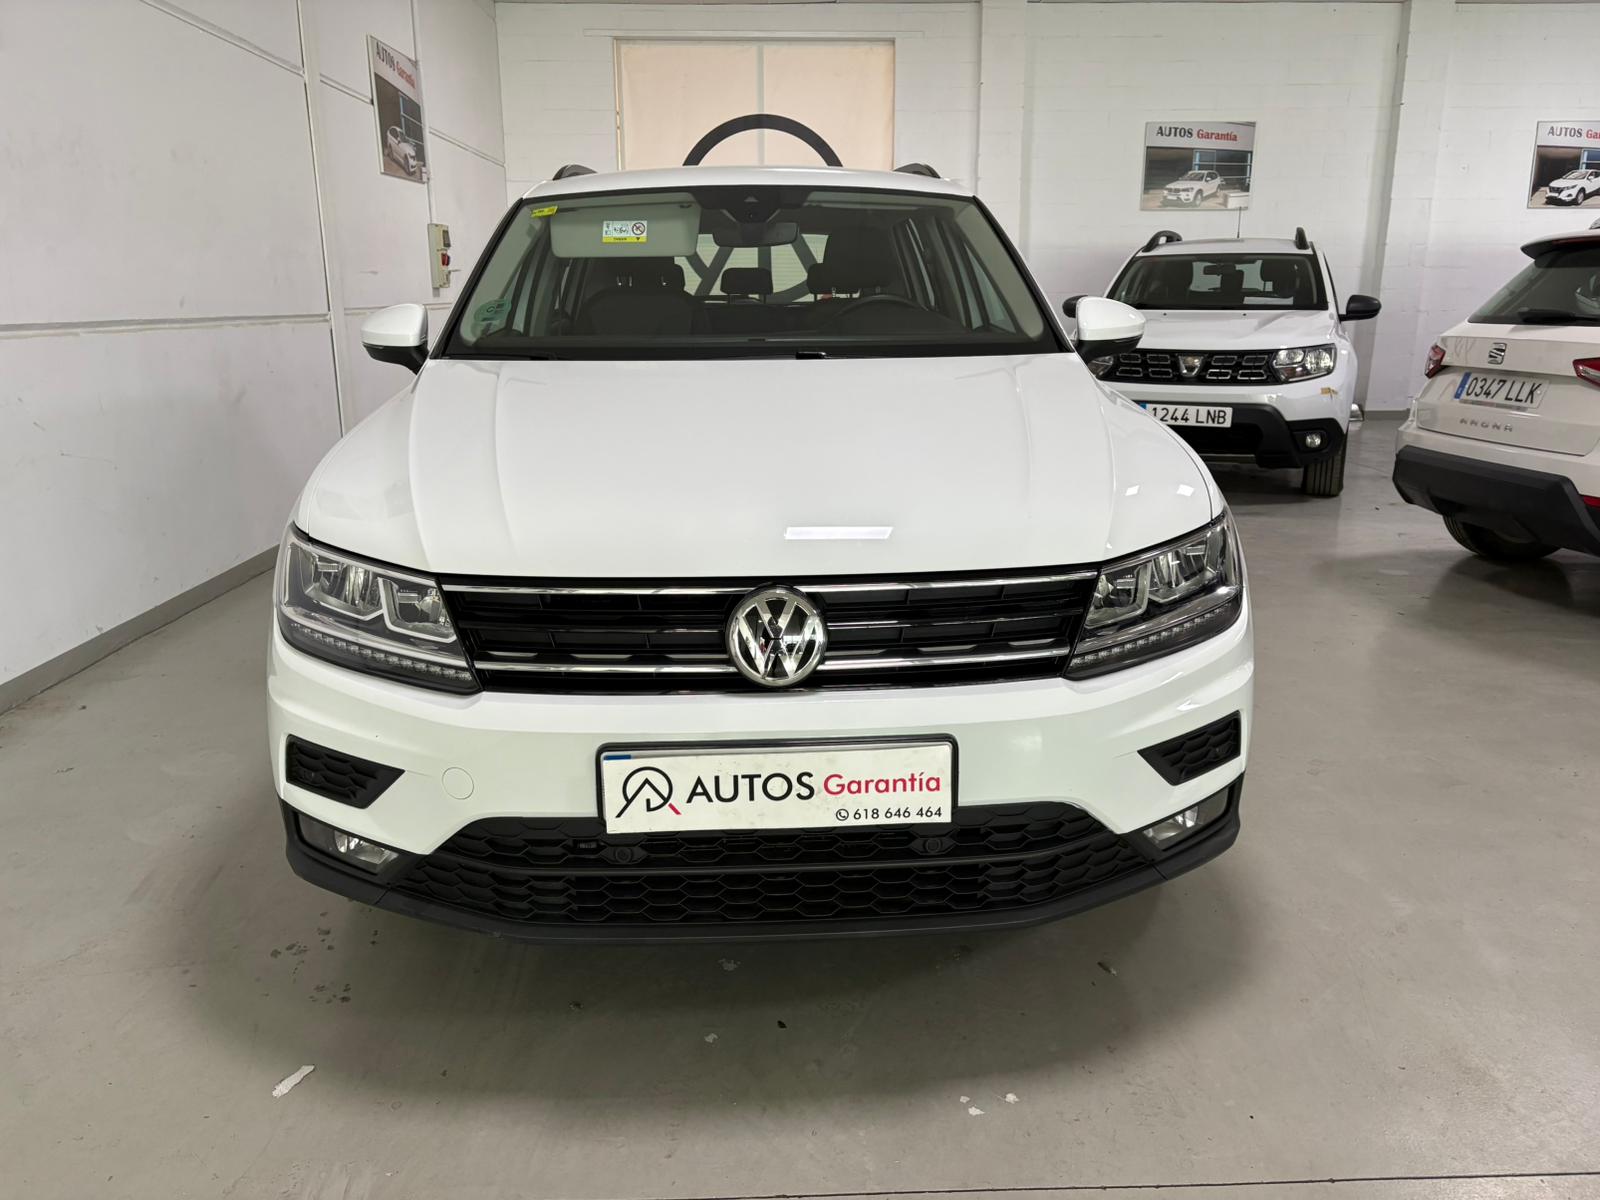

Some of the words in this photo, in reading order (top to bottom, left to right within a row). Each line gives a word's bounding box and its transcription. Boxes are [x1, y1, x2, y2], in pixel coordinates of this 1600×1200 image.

[1156, 126, 1194, 138] AUTOS
[1196, 128, 1238, 142] Garantía
[1547, 126, 1583, 138] AUTOS
[1465, 376, 1507, 399] 0347
[1504, 380, 1543, 404] LLK
[1152, 407, 1190, 423] 1244
[1195, 408, 1227, 425] LNB
[686, 771, 815, 804] AUTOS
[822, 771, 941, 796] Garantía
[853, 808, 880, 820] 618
[884, 807, 911, 819] 646
[916, 806, 942, 818] 464
